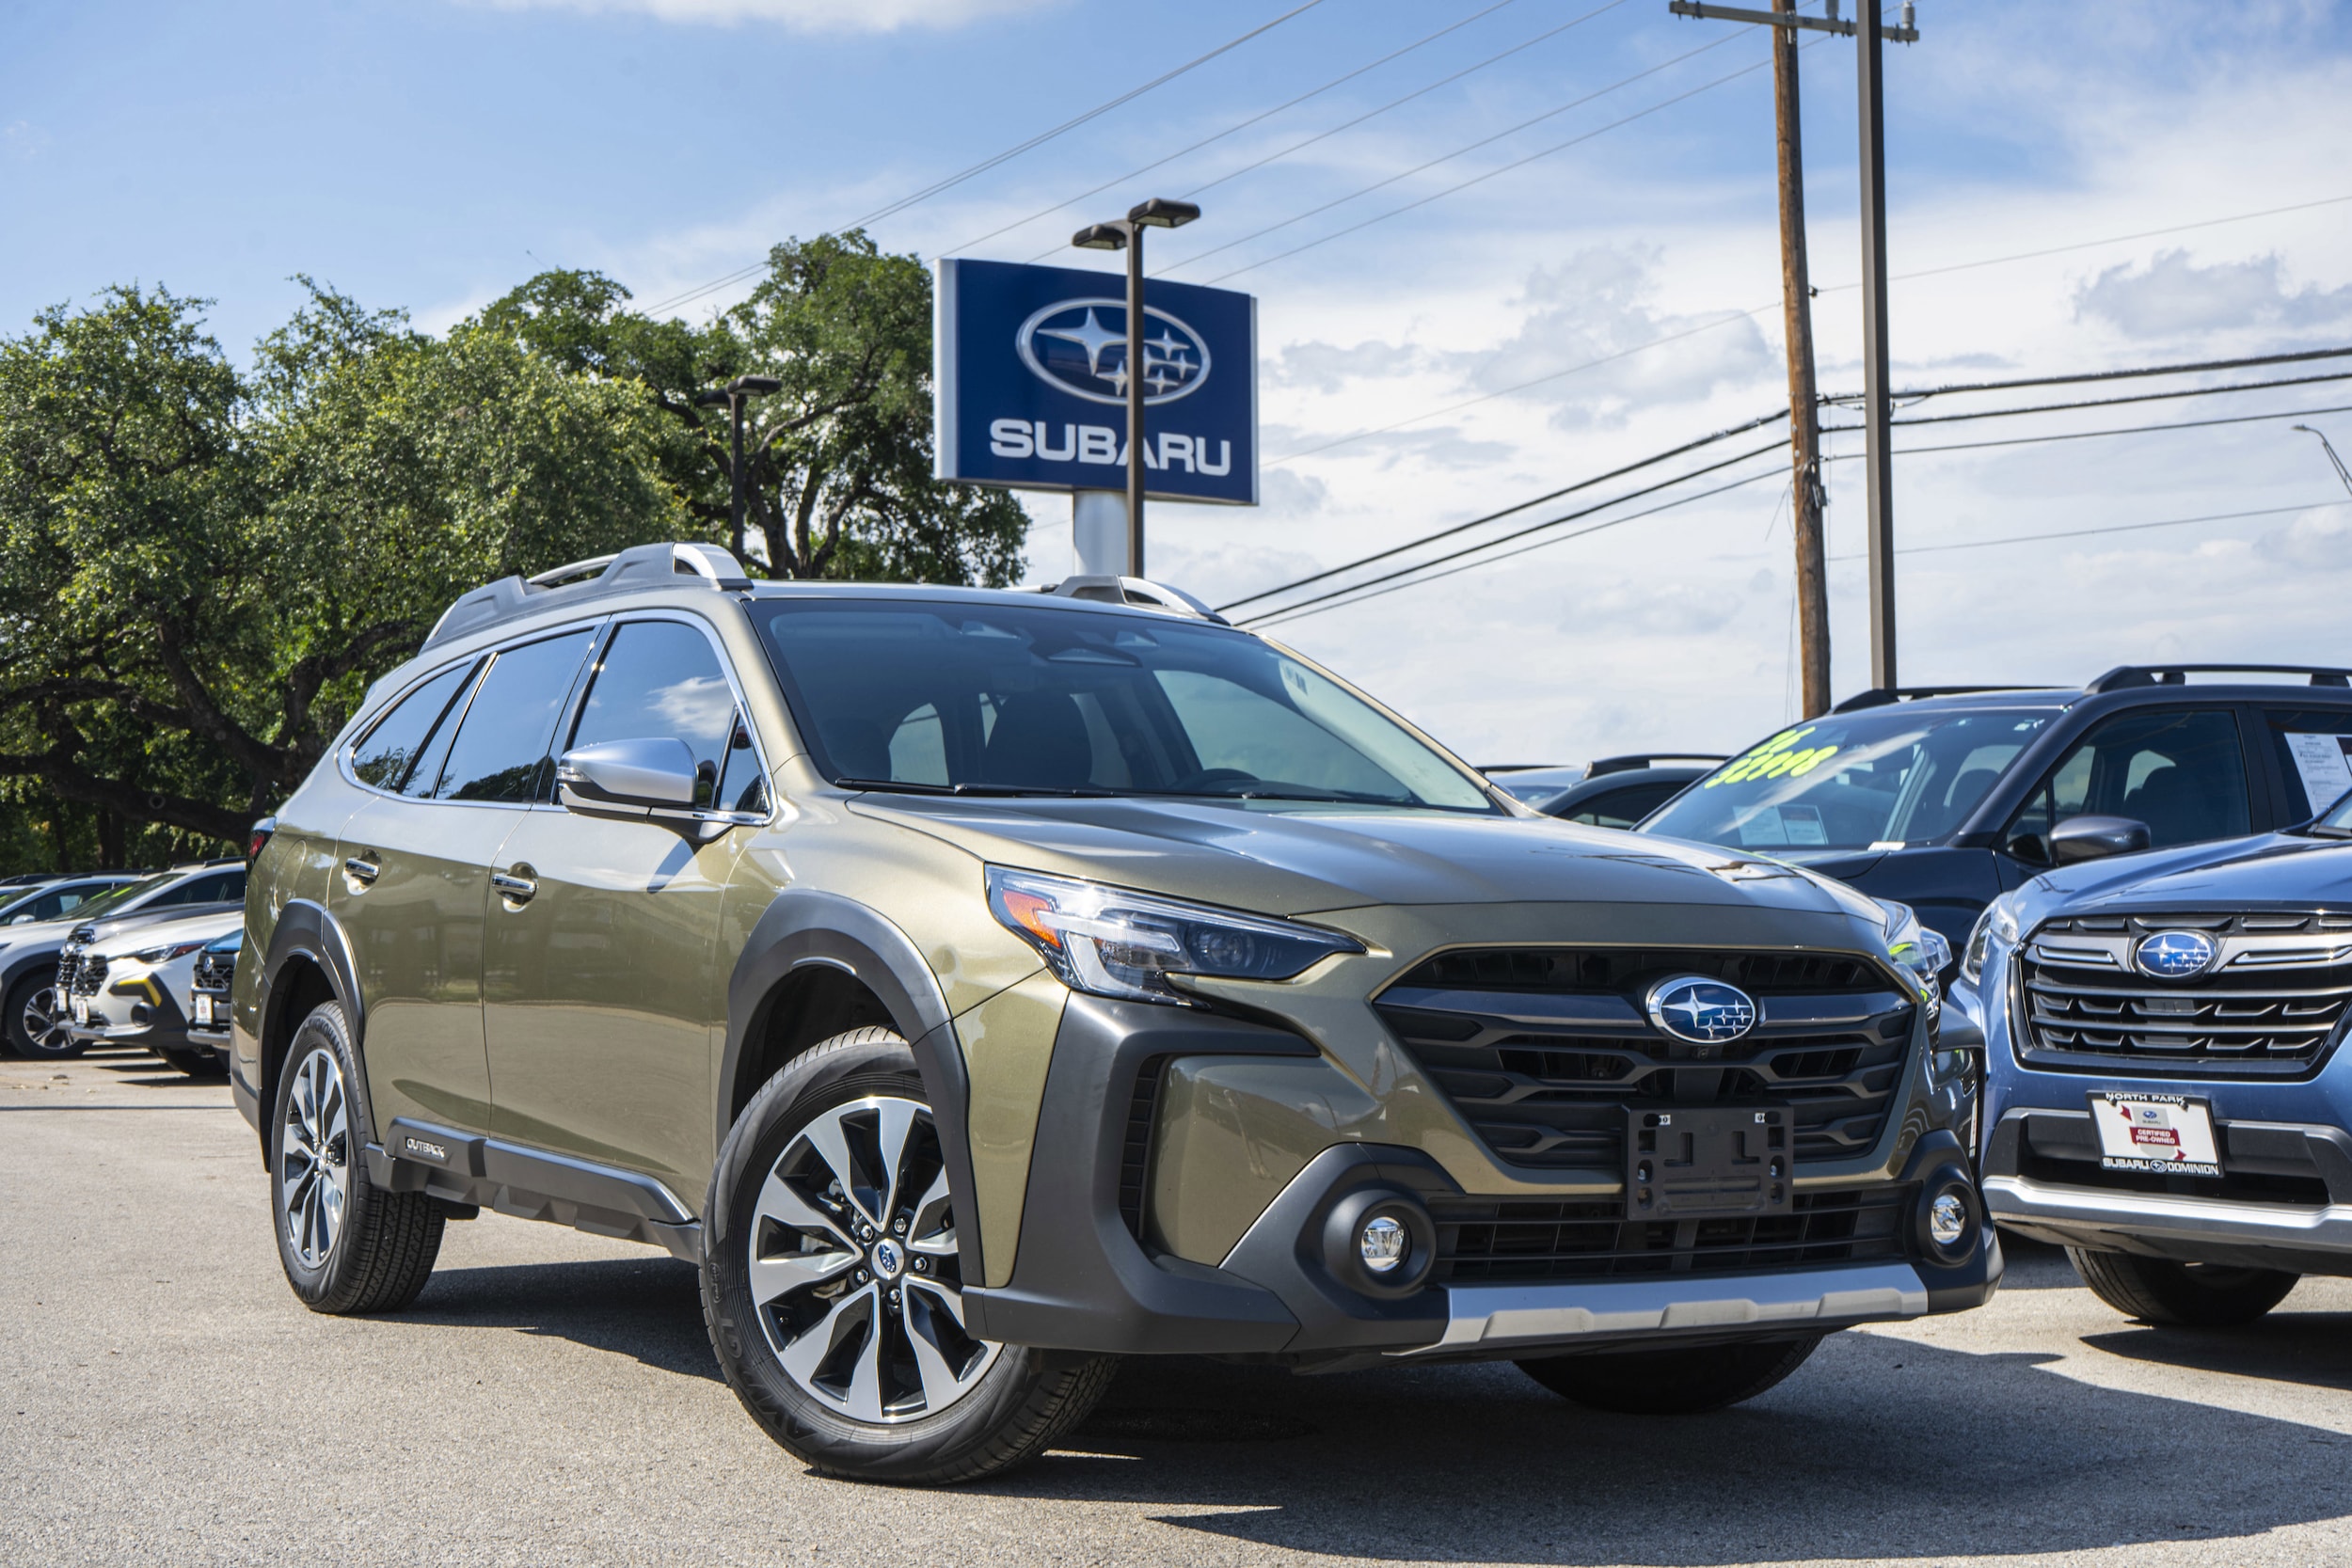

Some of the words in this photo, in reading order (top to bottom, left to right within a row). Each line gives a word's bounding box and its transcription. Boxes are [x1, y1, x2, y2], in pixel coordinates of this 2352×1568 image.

[990, 419, 1231, 477] SUBARU
[2106, 1092, 2148, 1102] NORTH
[2151, 1095, 2185, 1103] PARK
[2136, 1135, 2176, 1145] PRE-OWNED
[2137, 1129, 2171, 1137] CERTIFIED
[406, 1138, 445, 1159] OUTBACK
[2103, 1157, 2150, 1170] SUBARU
[2167, 1164, 2219, 1175] DOMINION
